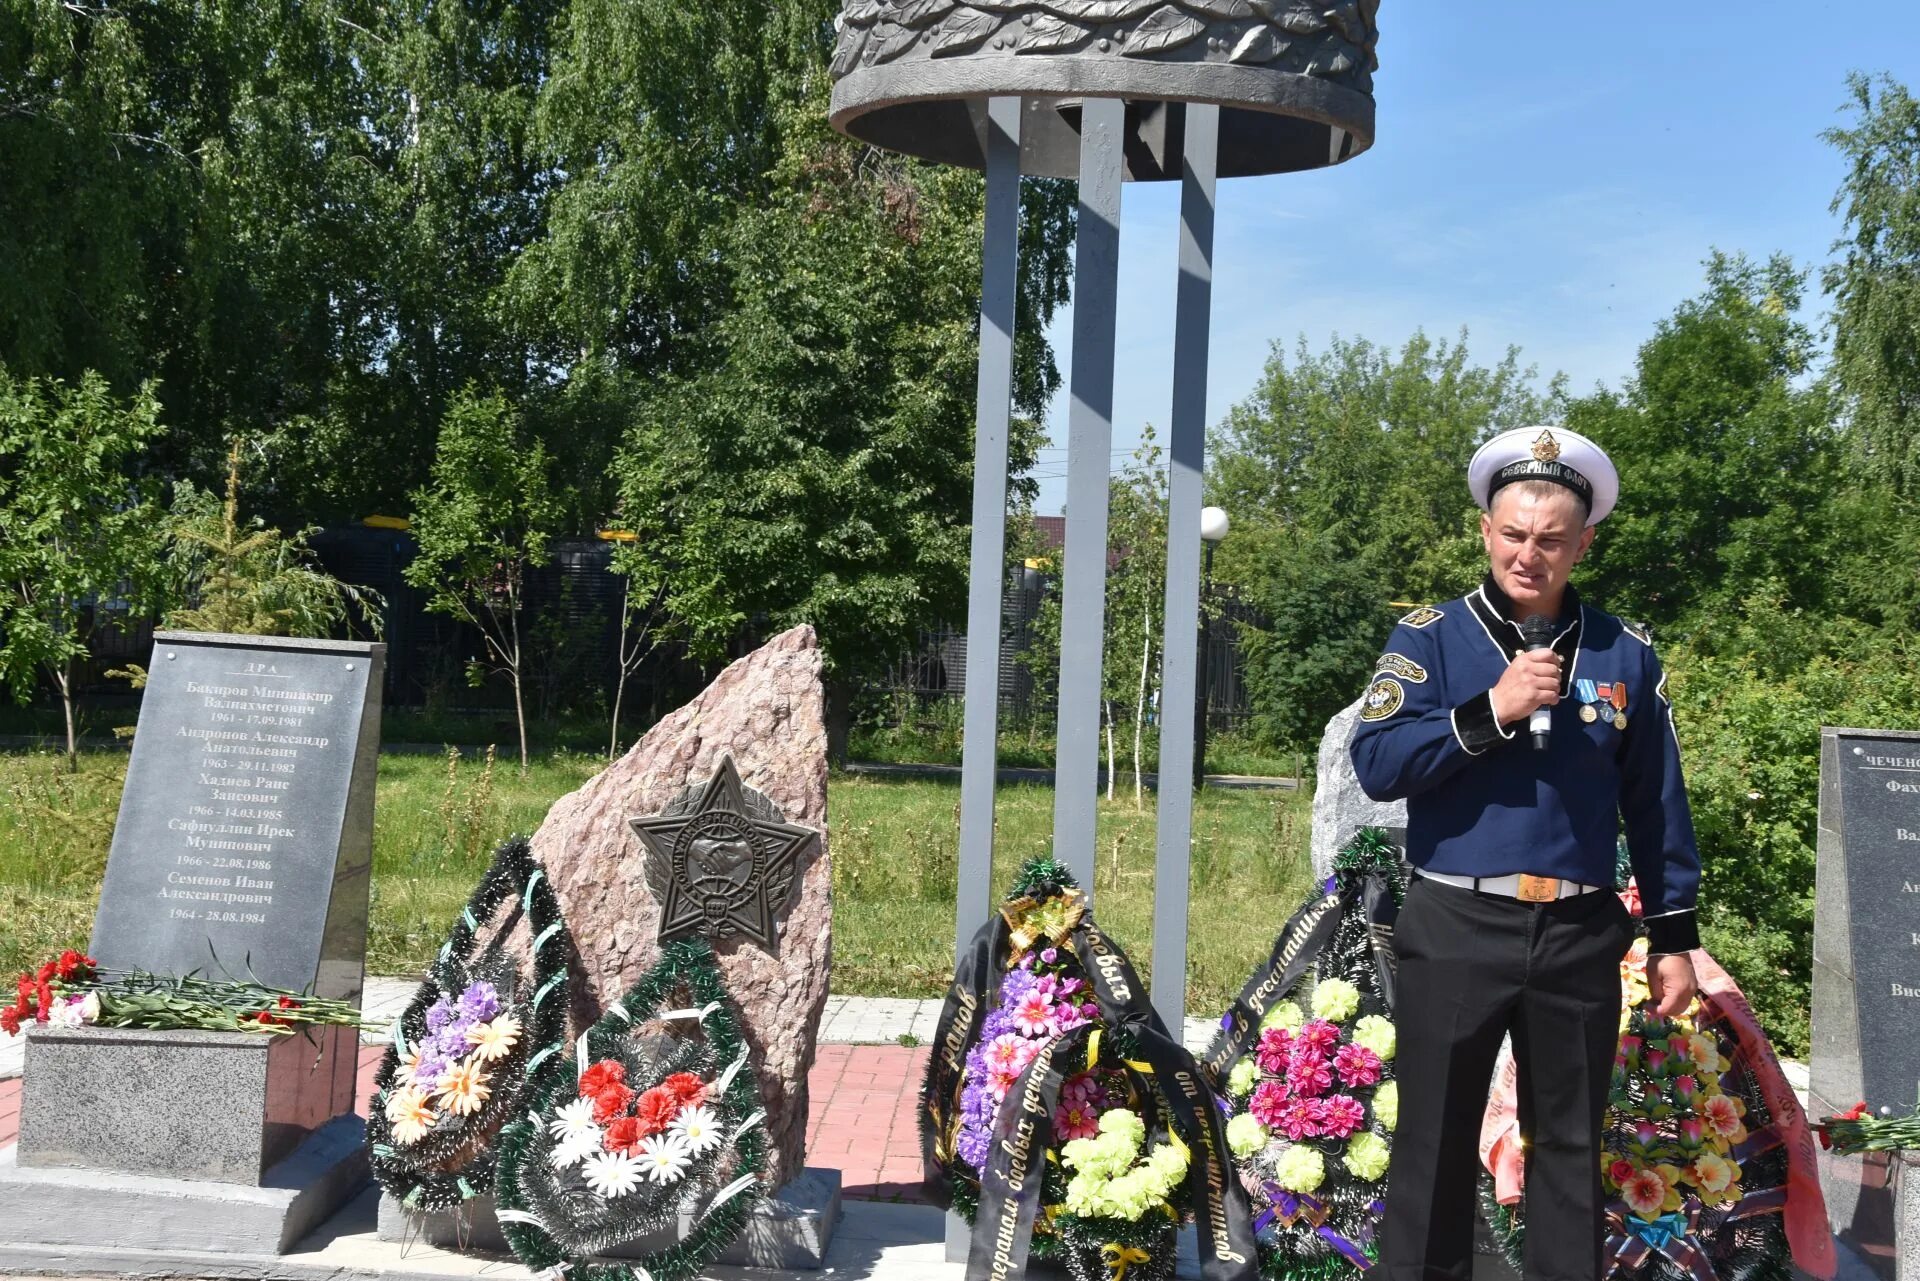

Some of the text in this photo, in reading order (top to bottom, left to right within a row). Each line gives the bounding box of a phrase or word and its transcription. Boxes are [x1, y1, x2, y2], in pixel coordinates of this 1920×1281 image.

[1501, 461, 1588, 491] СЕВЕРНЫЙ ФЛОТ
[243, 662, 278, 674] ДРА
[186, 681, 334, 703] Бакиров Миншакир
[204, 696, 316, 715] Валиахметович
[210, 712, 235, 724] 1961
[246, 714, 303, 727] 17.09.1981
[176, 726, 329, 749] Андронов Александр
[201, 741, 298, 758] Анатольевич
[202, 759, 227, 769] 1963
[238, 761, 296, 774] 29.11.1982
[198, 773, 290, 790] Хадиев Раис
[188, 805, 216, 817] 1966
[224, 807, 283, 821] 14.03.1985
[168, 819, 295, 839] Сафиуллин Ирек
[1896, 828, 1920, 841] Ва
[185, 836, 272, 853] Мунипович
[176, 855, 203, 866] 1966
[212, 857, 272, 870] 22.08.1986
[167, 872, 274, 889] Семенов Иван
[156, 887, 272, 905] Александрович
[169, 909, 196, 920] 1964
[206, 910, 265, 924] 28.08.1984
[946, 985, 977, 1071] ранов
[995, 1119, 1036, 1191] боевых
[1022, 1030, 1066, 1117] действи
[1174, 1071, 1246, 1265] от пограничников
